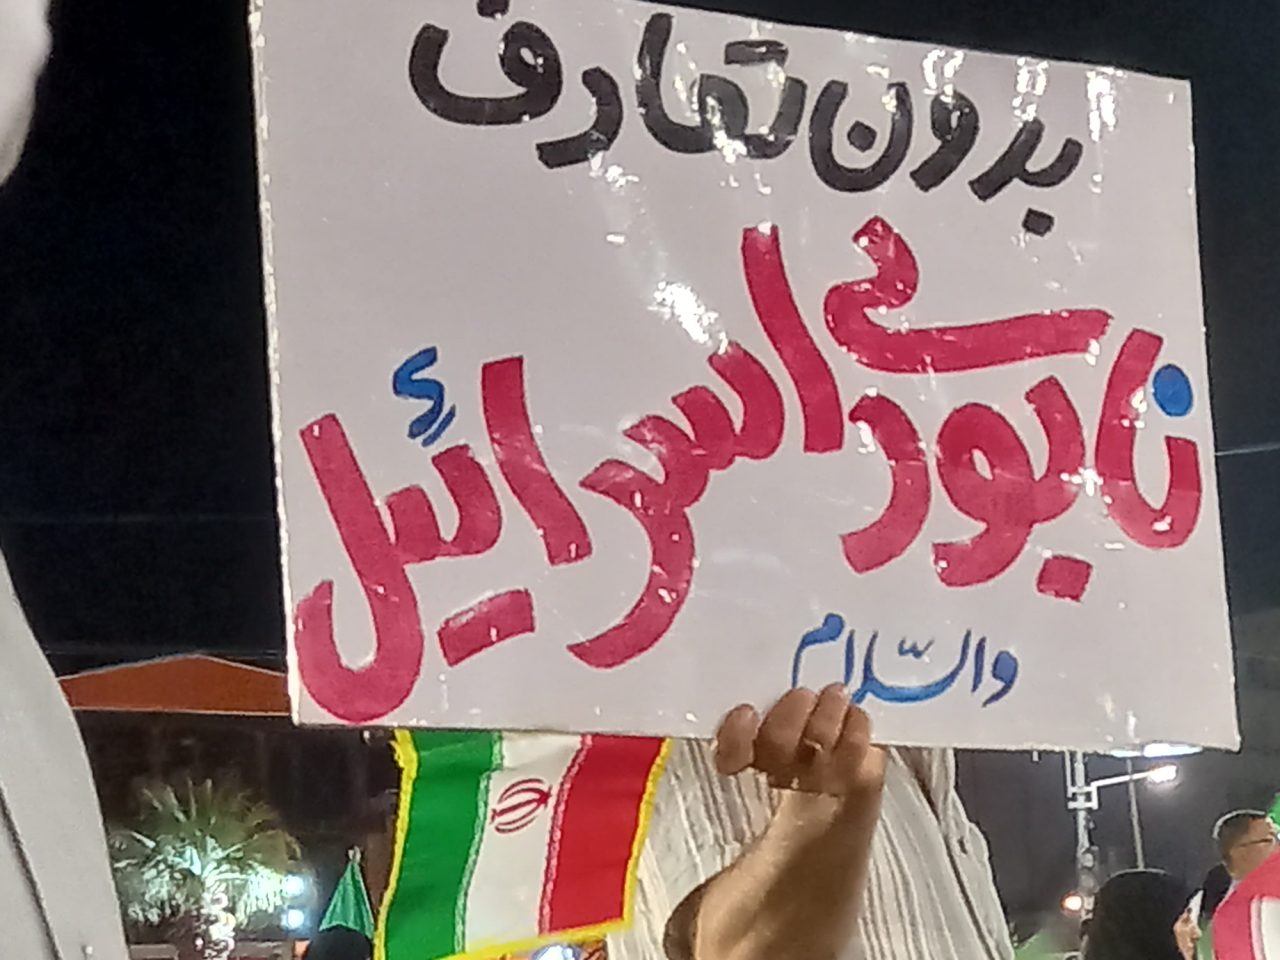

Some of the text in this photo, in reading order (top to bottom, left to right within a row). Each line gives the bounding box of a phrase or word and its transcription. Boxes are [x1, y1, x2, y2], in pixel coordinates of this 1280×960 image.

[408, 0, 1083, 237] بدون تعارف
[294, 214, 1202, 724] نابودی اسرائیل
